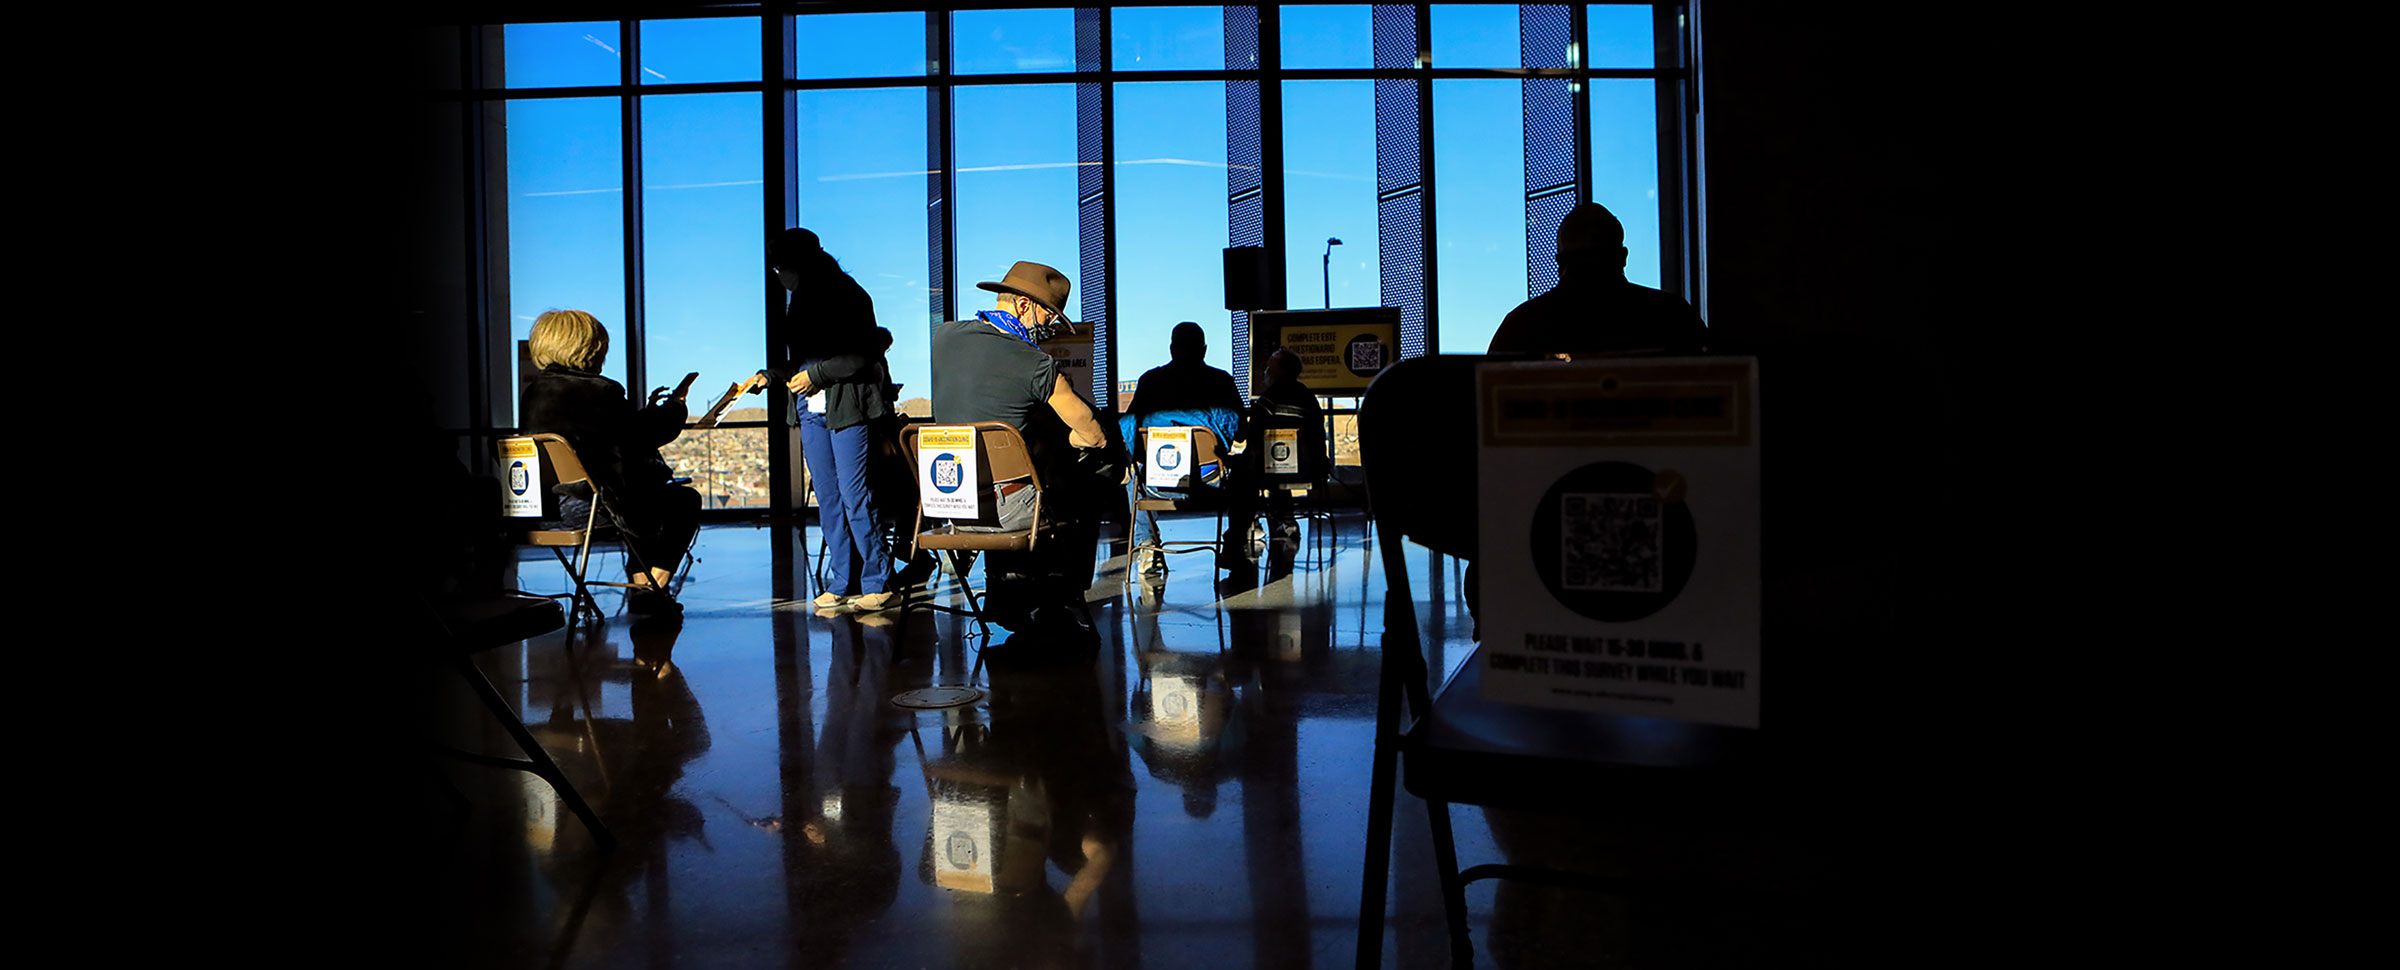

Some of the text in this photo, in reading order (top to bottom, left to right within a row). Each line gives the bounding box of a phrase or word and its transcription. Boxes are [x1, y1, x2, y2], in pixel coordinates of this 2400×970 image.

[1288, 331, 1336, 343] COMPLETE ESTE
[1118, 381, 1137, 392] UTE
[1525, 633, 1568, 653] PLEASE
[1572, 636, 1603, 654] WAIT
[1489, 652, 1745, 689] COMPLETE THIS SURVEY WHILE YOU WAIT
